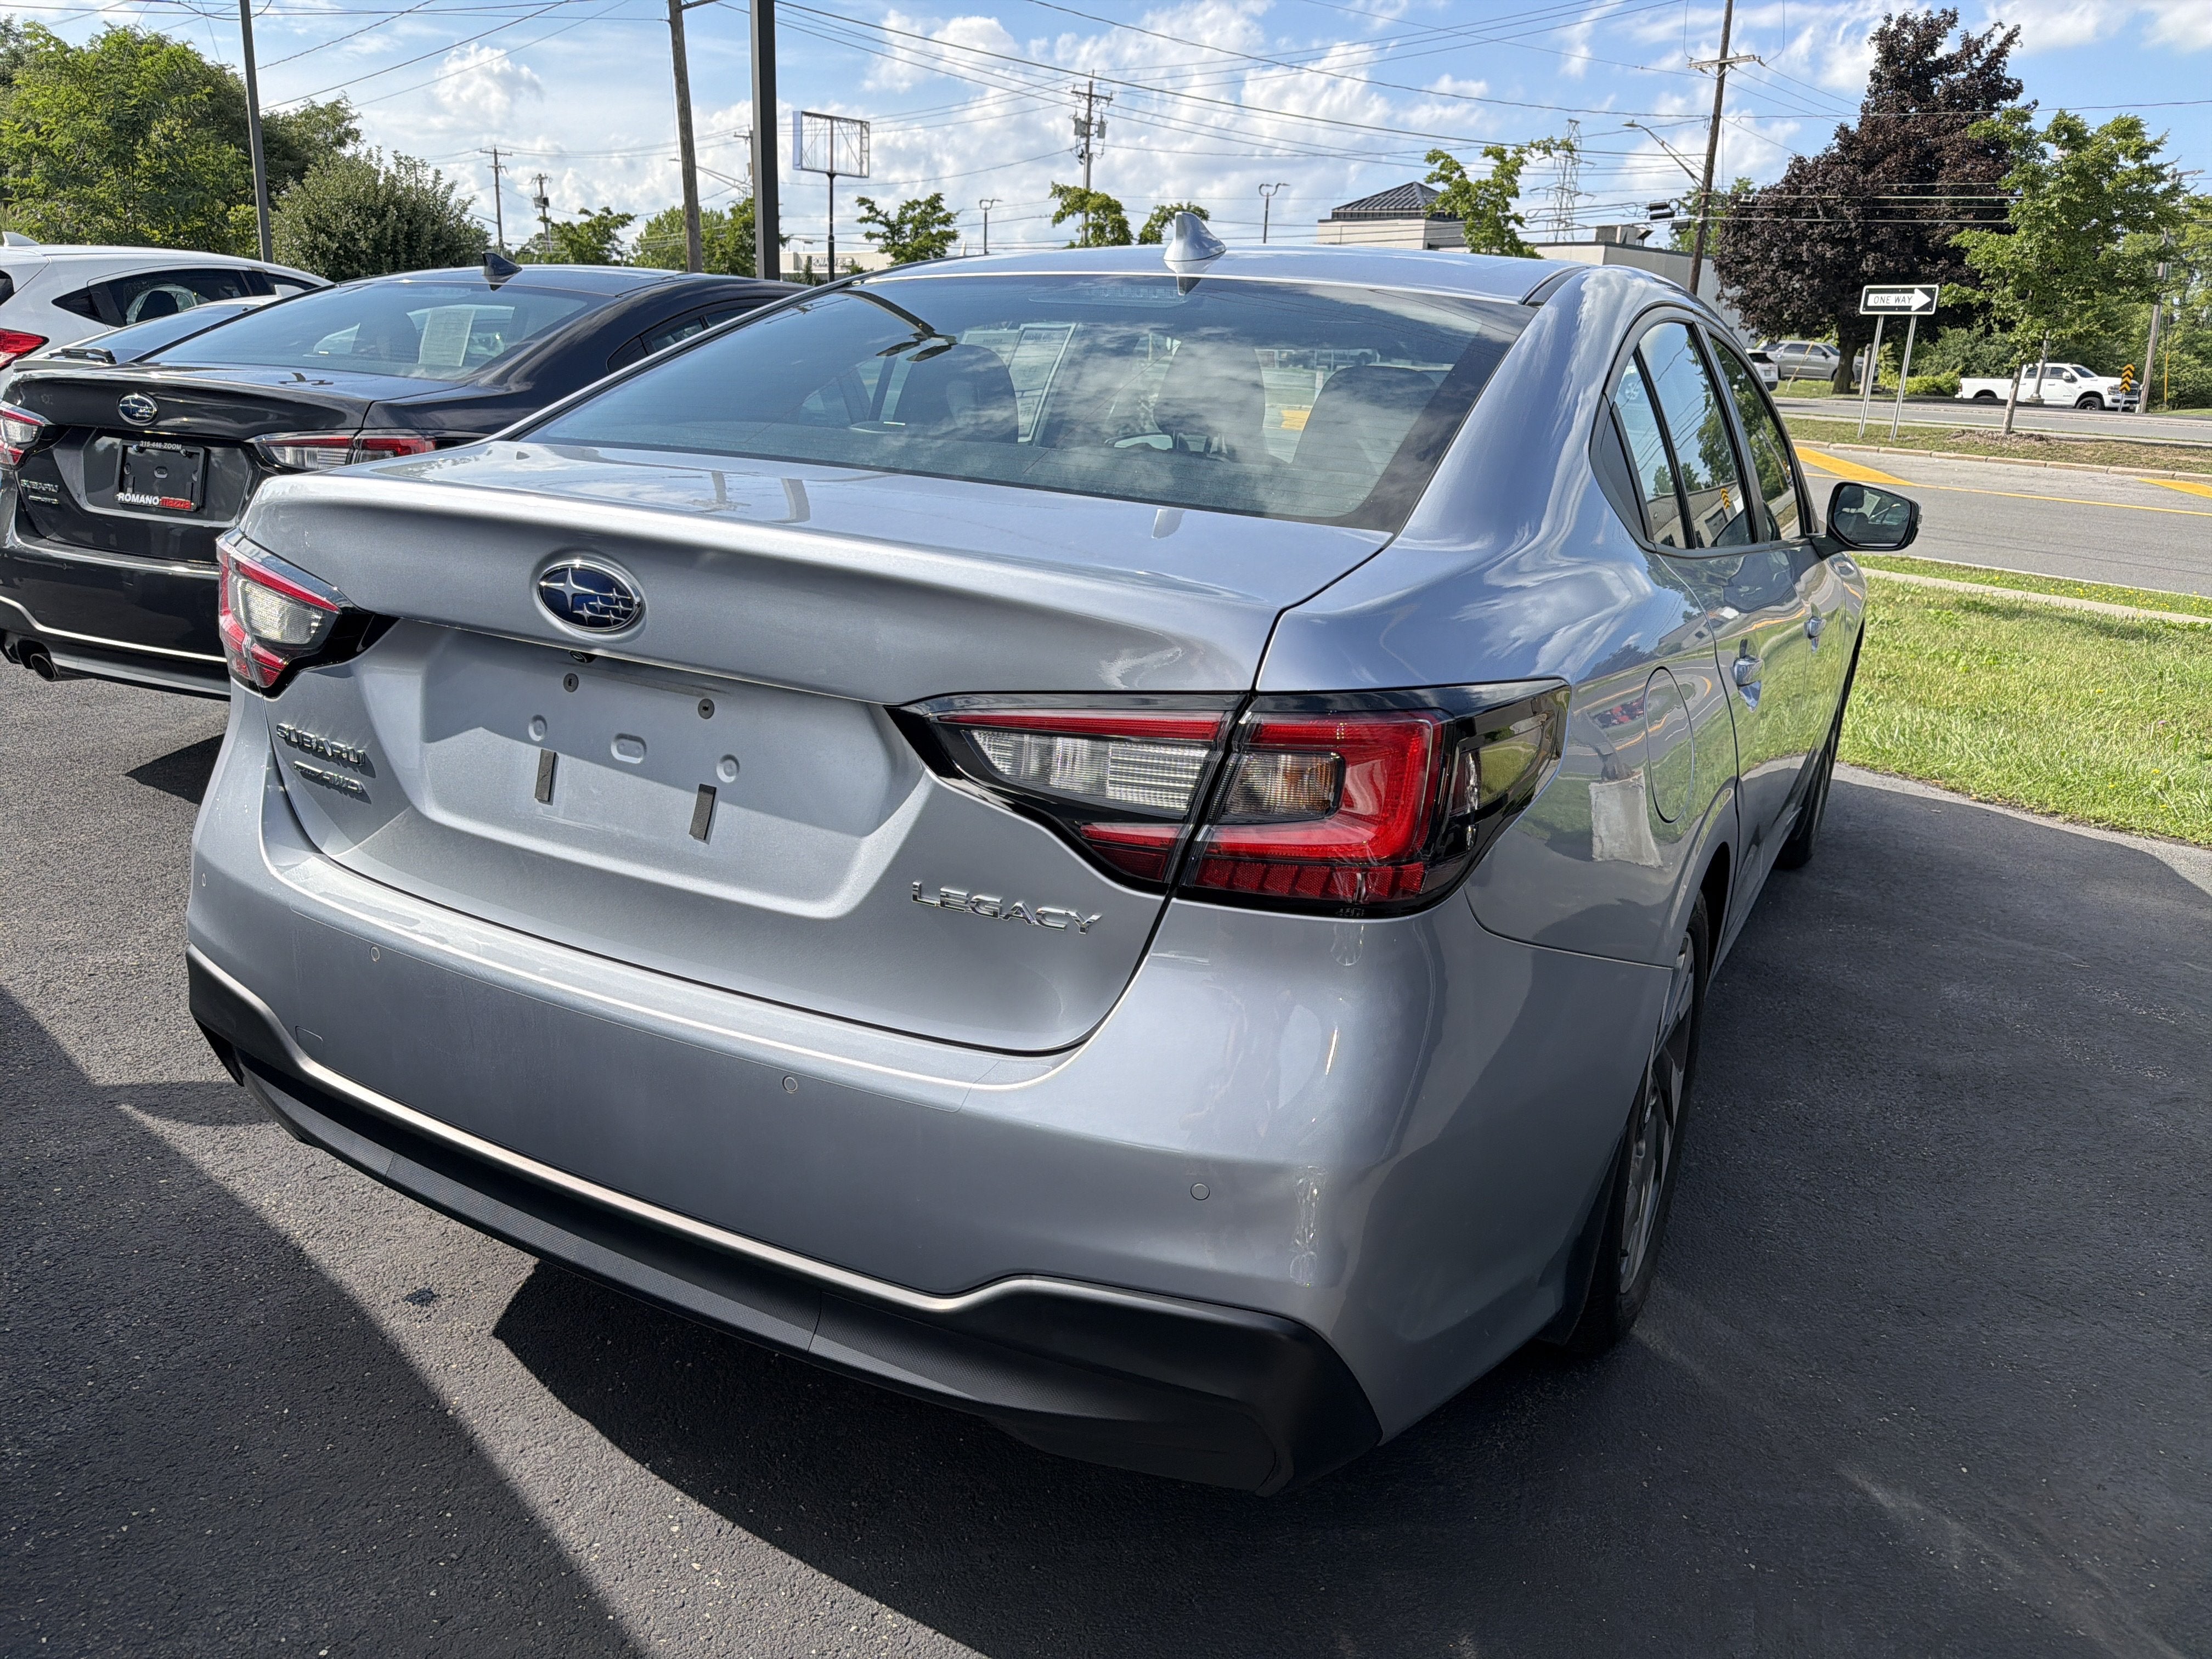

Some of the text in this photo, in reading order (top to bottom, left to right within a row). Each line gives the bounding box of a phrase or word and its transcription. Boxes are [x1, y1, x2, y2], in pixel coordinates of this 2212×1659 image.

[1874, 296, 1913, 304] ONE WAY
[117, 492, 160, 506] ROMANO
[276, 723, 366, 766] SUBARU
[911, 881, 1102, 934] LEGACY
